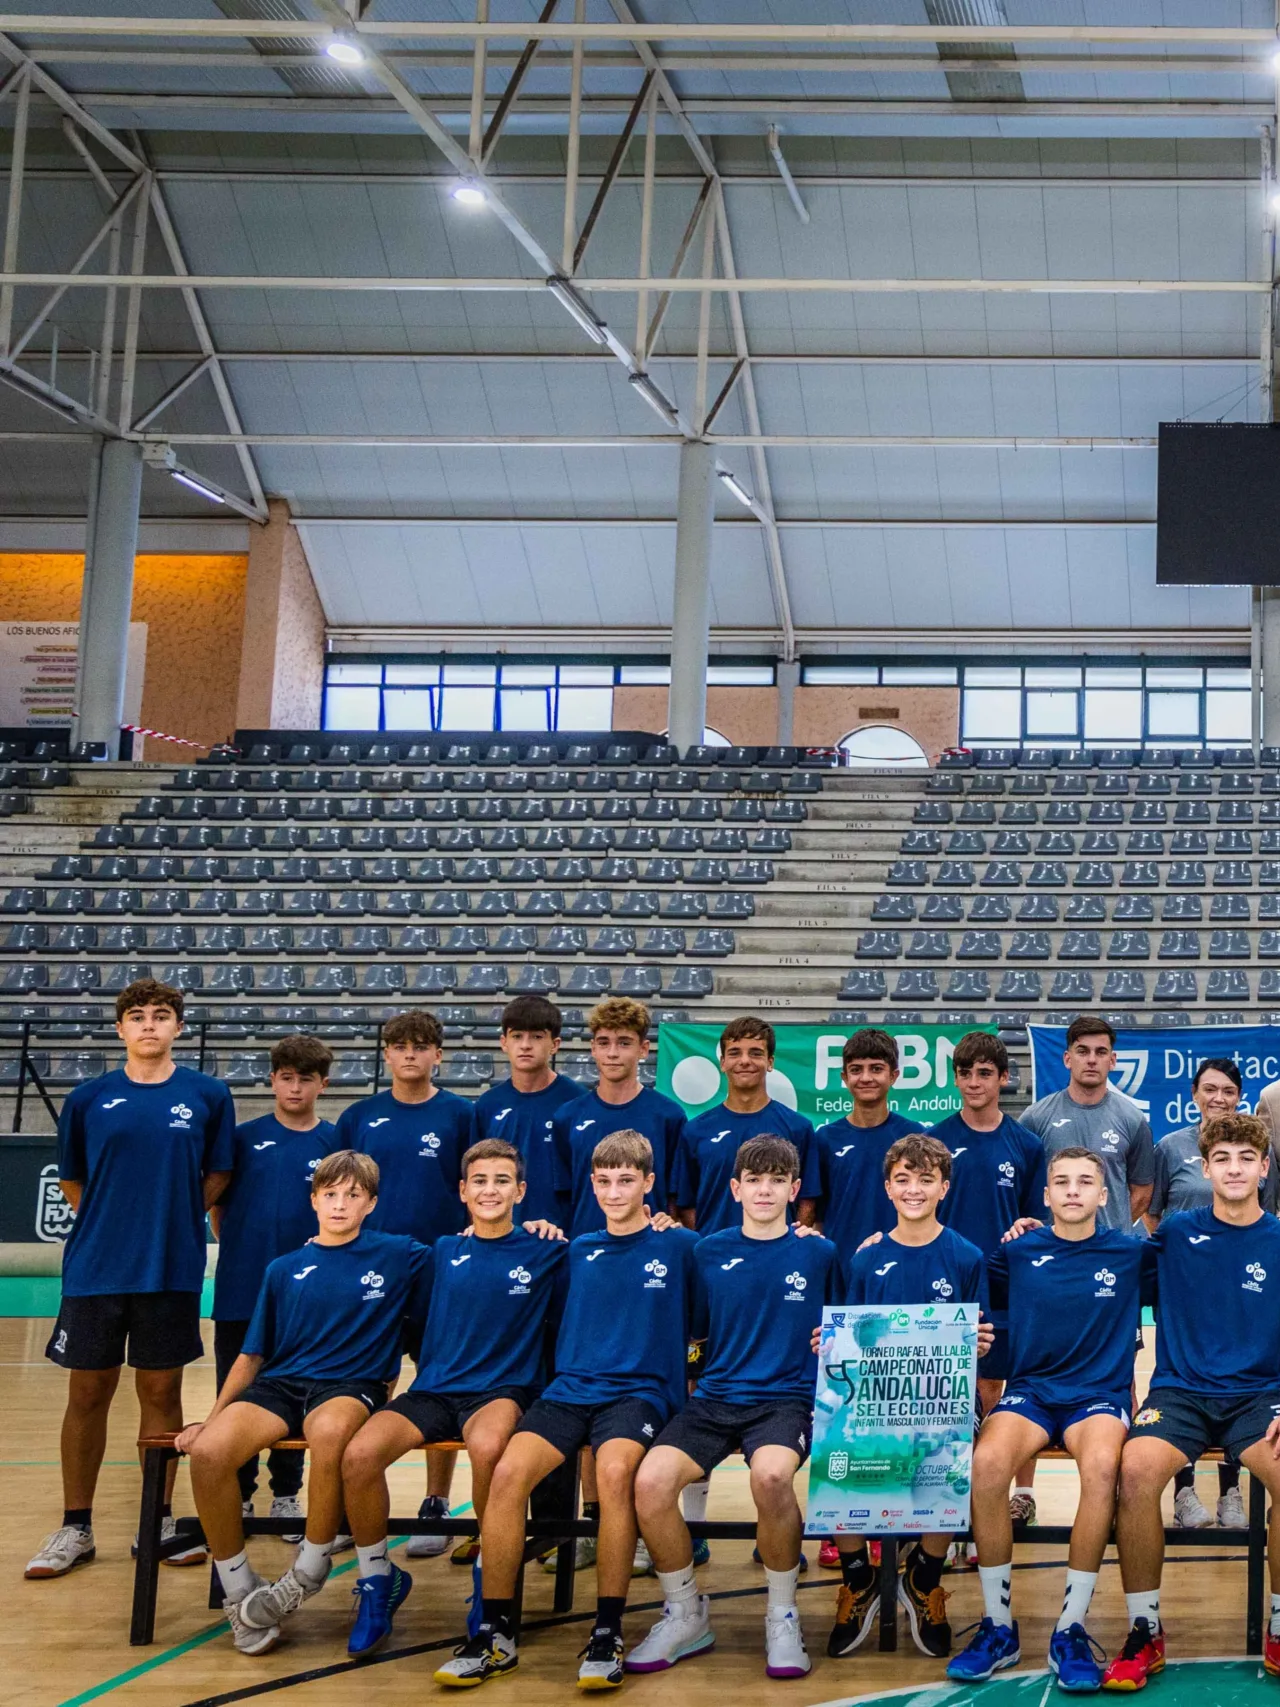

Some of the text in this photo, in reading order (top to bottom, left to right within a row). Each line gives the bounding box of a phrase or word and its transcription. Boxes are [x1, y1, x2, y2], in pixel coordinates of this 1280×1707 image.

[7, 627, 23, 635] LOS
[25, 627, 60, 635] BUENOS
[816, 1095, 964, 1112] Feden Andalu
[1165, 1094, 1200, 1124] de
[861, 1345, 972, 1358] TORNEO RAFAEL VILLALBA
[858, 1358, 972, 1376] CAMPEONATO DE
[857, 1371, 970, 1401] ANDALUCÍA
[856, 1402, 970, 1416] SELECCIONES
[855, 1417, 968, 1427] INFANTIL MASCULINO Y FEMENINO
[916, 1464, 953, 1475] OCTUBRE
